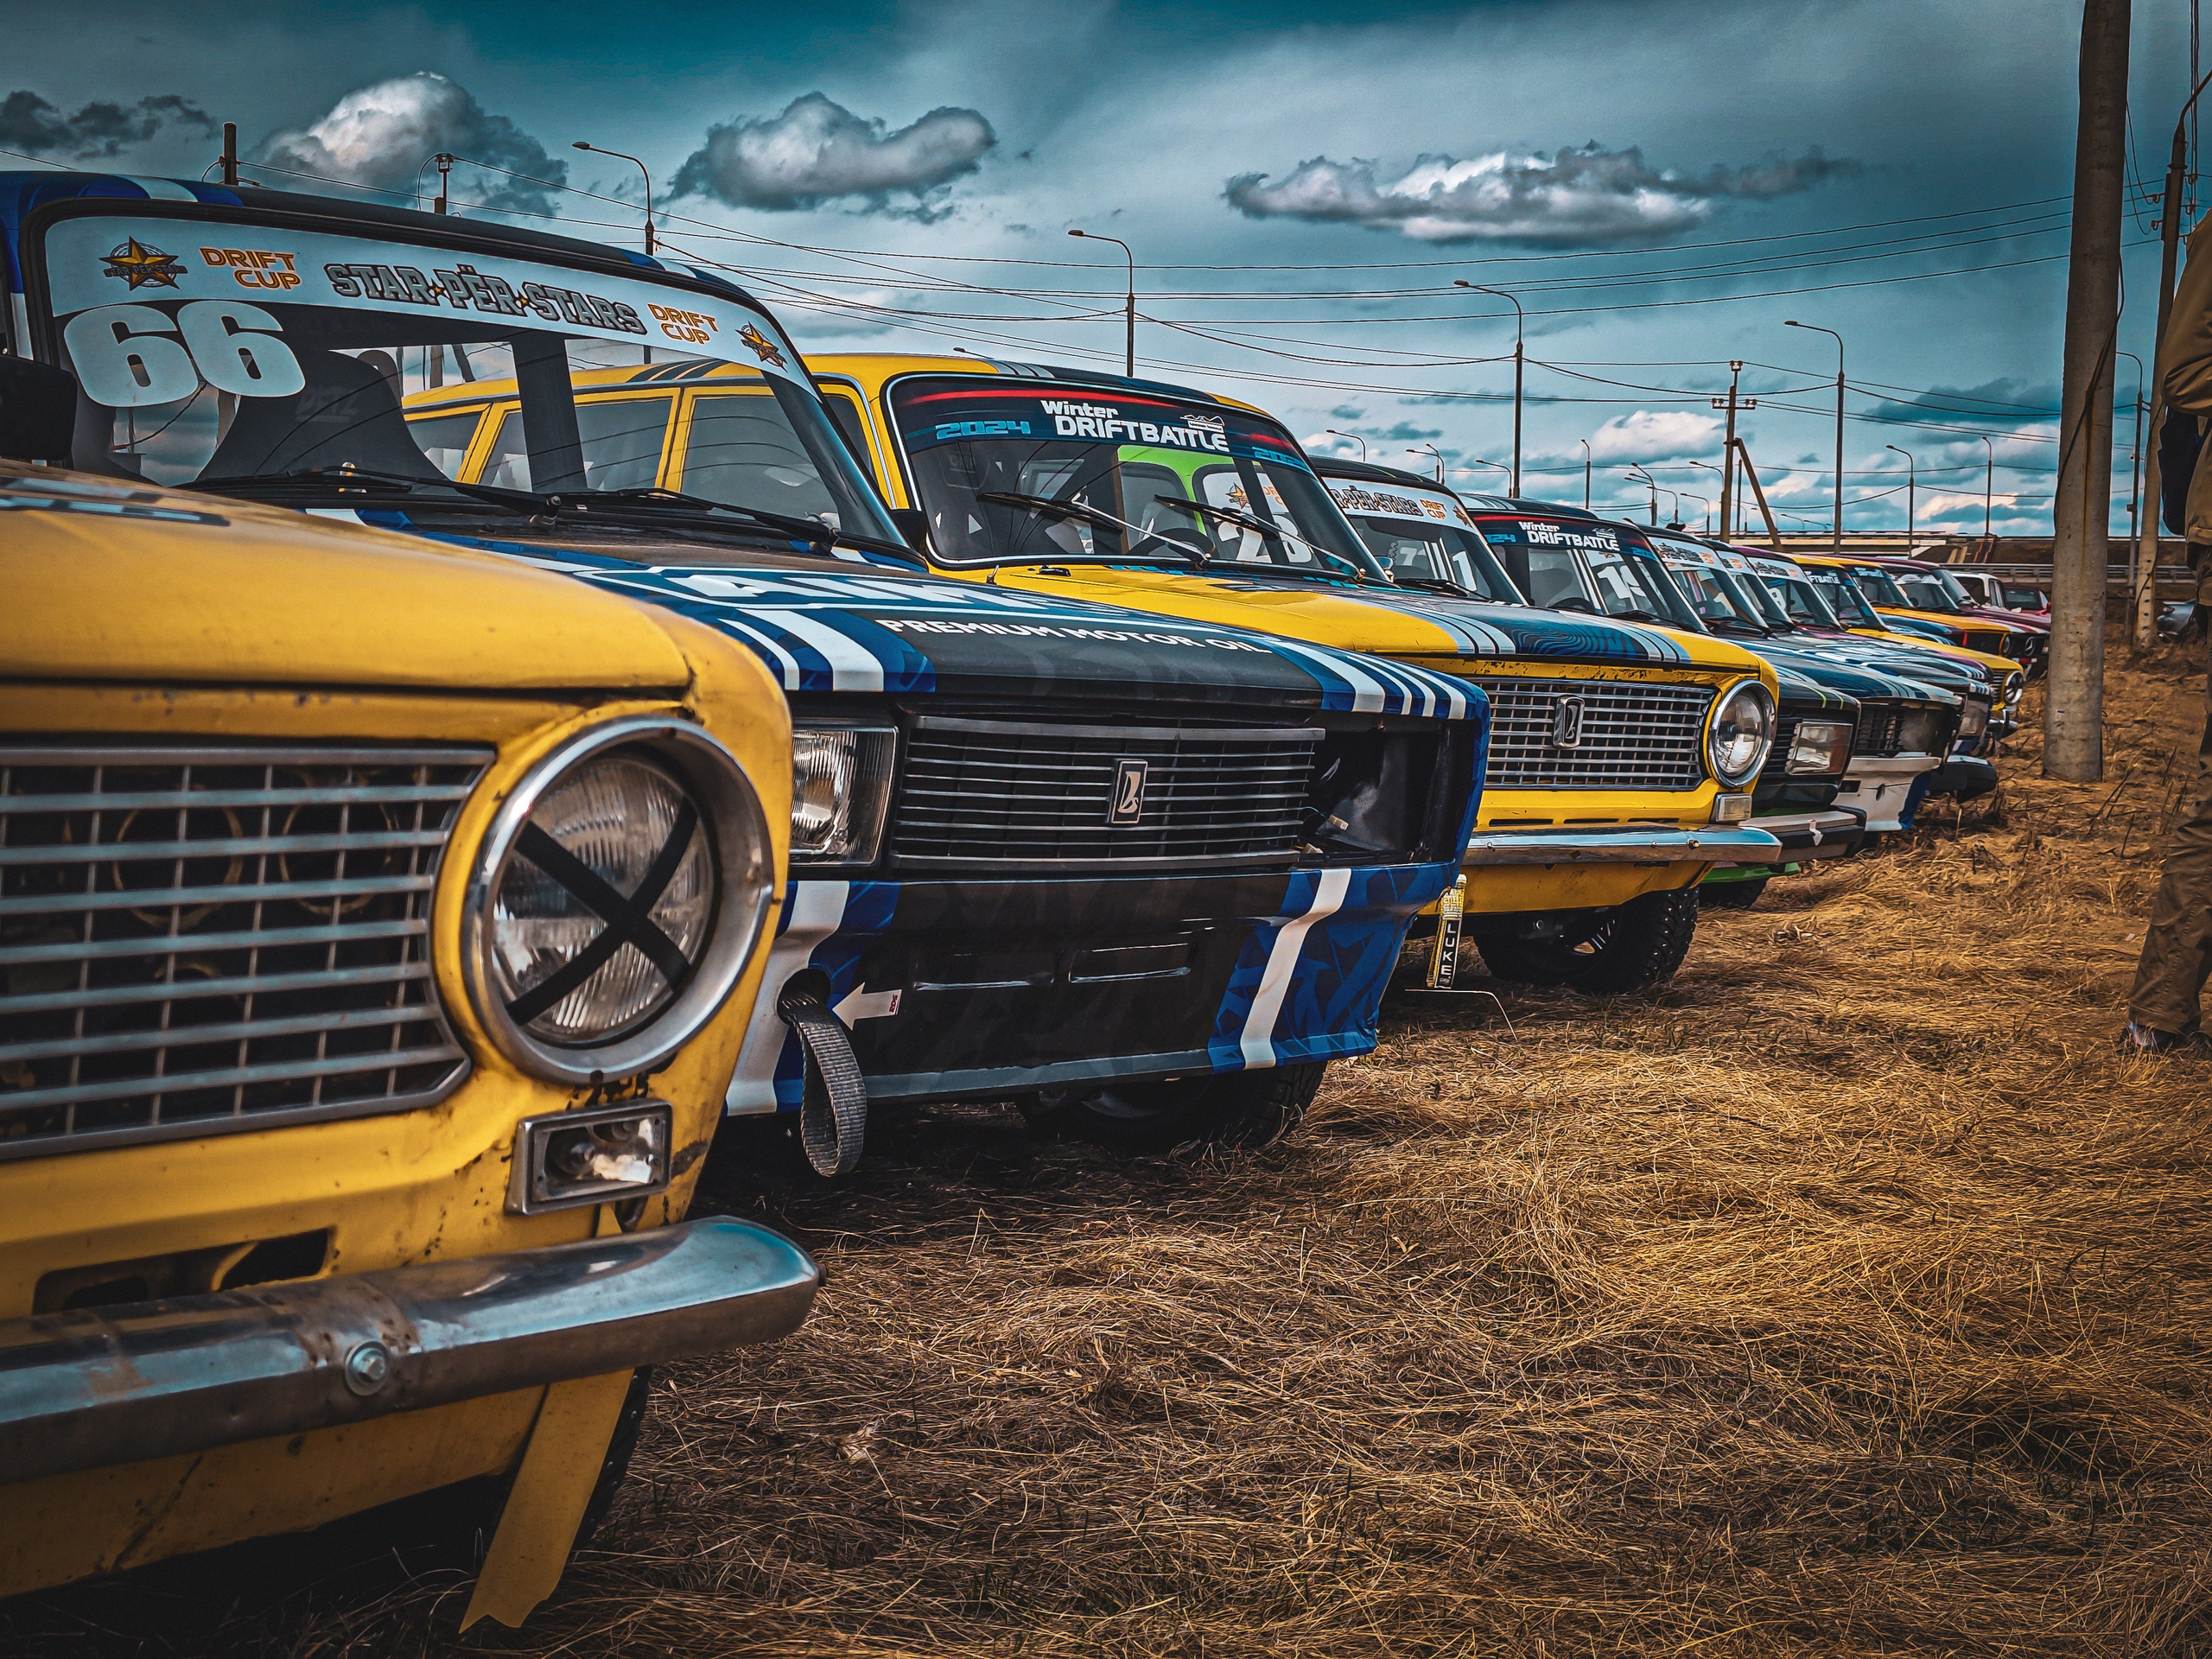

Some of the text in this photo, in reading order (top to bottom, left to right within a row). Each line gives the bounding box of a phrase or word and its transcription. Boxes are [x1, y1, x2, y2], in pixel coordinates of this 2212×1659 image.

[199, 246, 295, 270] DRIFT
[233, 269, 302, 290] CUP
[322, 263, 434, 302] STAR
[518, 281, 648, 335] STARS
[648, 302, 718, 333] DRIFT
[659, 321, 711, 345] CUP
[64, 301, 306, 407] 66
[1040, 400, 1119, 418] Winter
[935, 421, 1032, 441] 2024
[1055, 415, 1230, 453] DRIFTBATTLE
[1419, 499, 1447, 512] DRIFT
[1427, 509, 1446, 520] CUP
[1517, 521, 1560, 532] Winter
[874, 618, 1273, 654] PREMIUM MOTOR OIL
